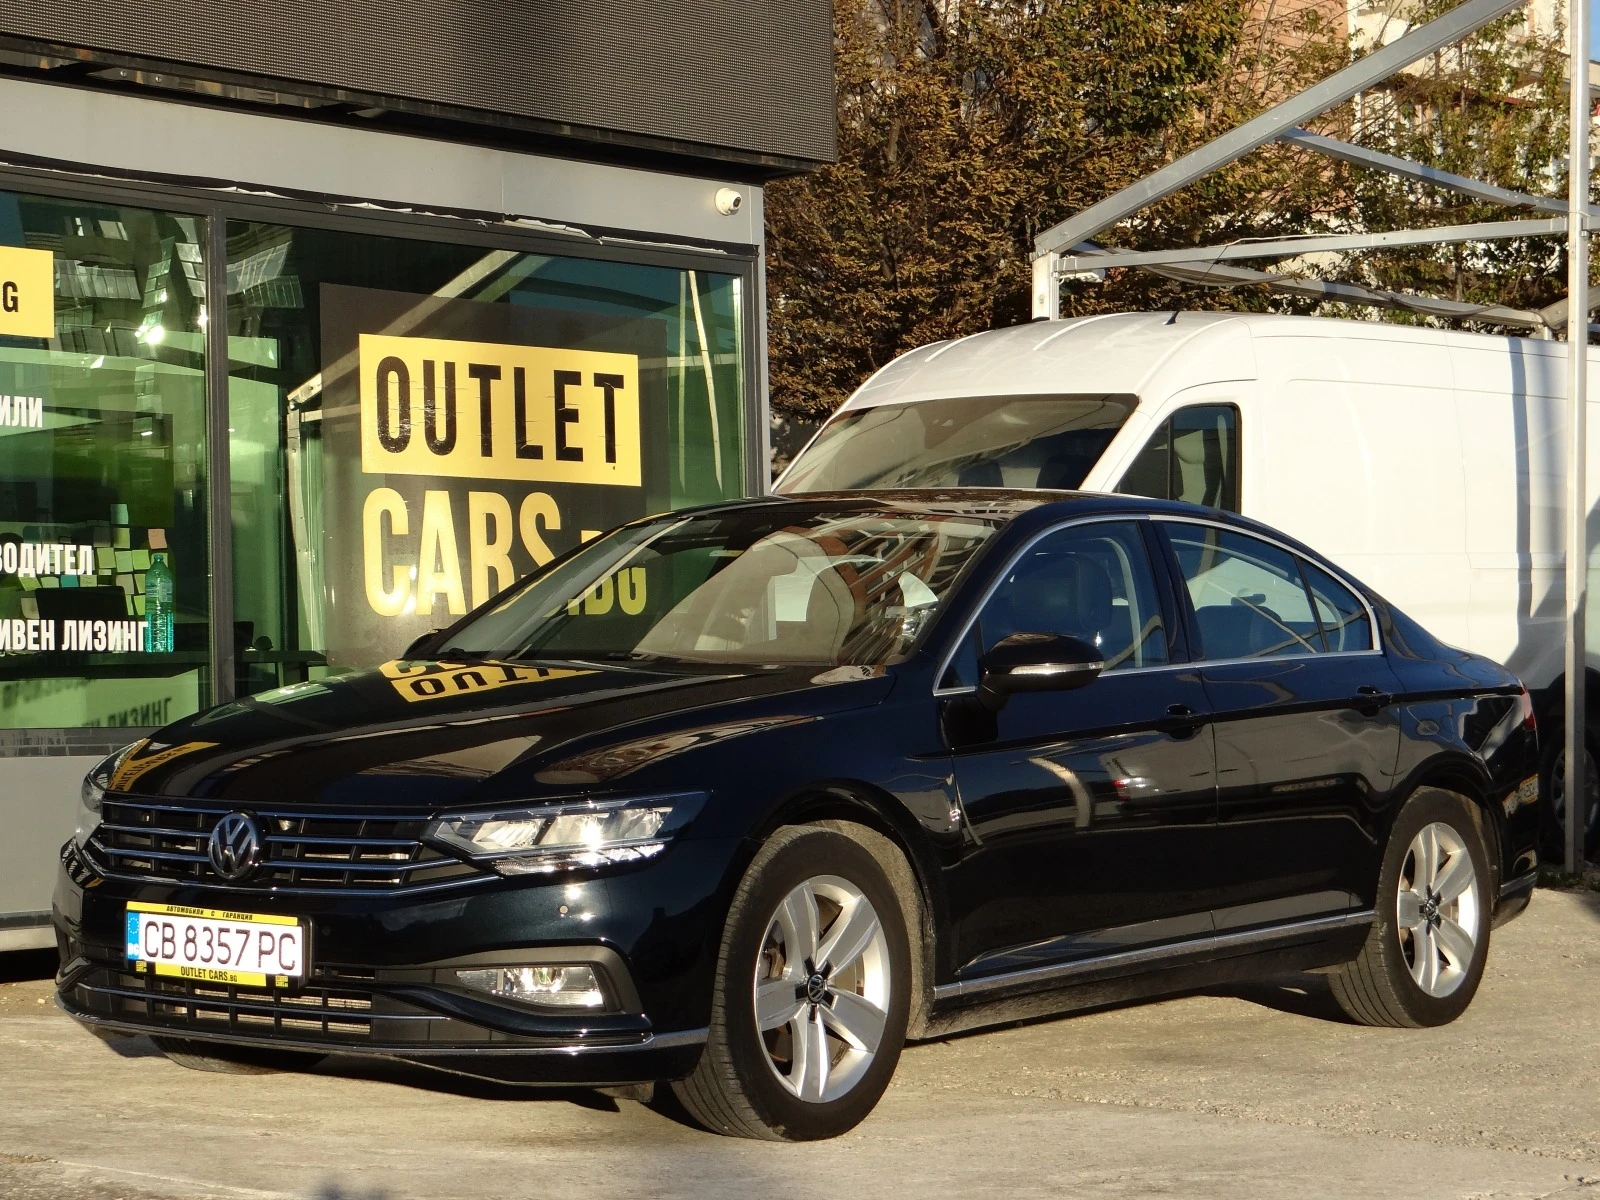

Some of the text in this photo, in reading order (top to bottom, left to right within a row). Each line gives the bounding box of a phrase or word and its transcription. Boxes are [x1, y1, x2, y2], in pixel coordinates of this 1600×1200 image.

[375, 355, 625, 464] OUTLET
[0, 541, 93, 578] ОДИТЕЛ
[62, 619, 149, 652] ЛИЗИНГ
[166, 905, 205, 916] АВТОМОБИЛИ
[222, 911, 254, 921] ГАРАНЦИЯ
[183, 924, 251, 967] 8357
[180, 965, 207, 979] OUTLET
